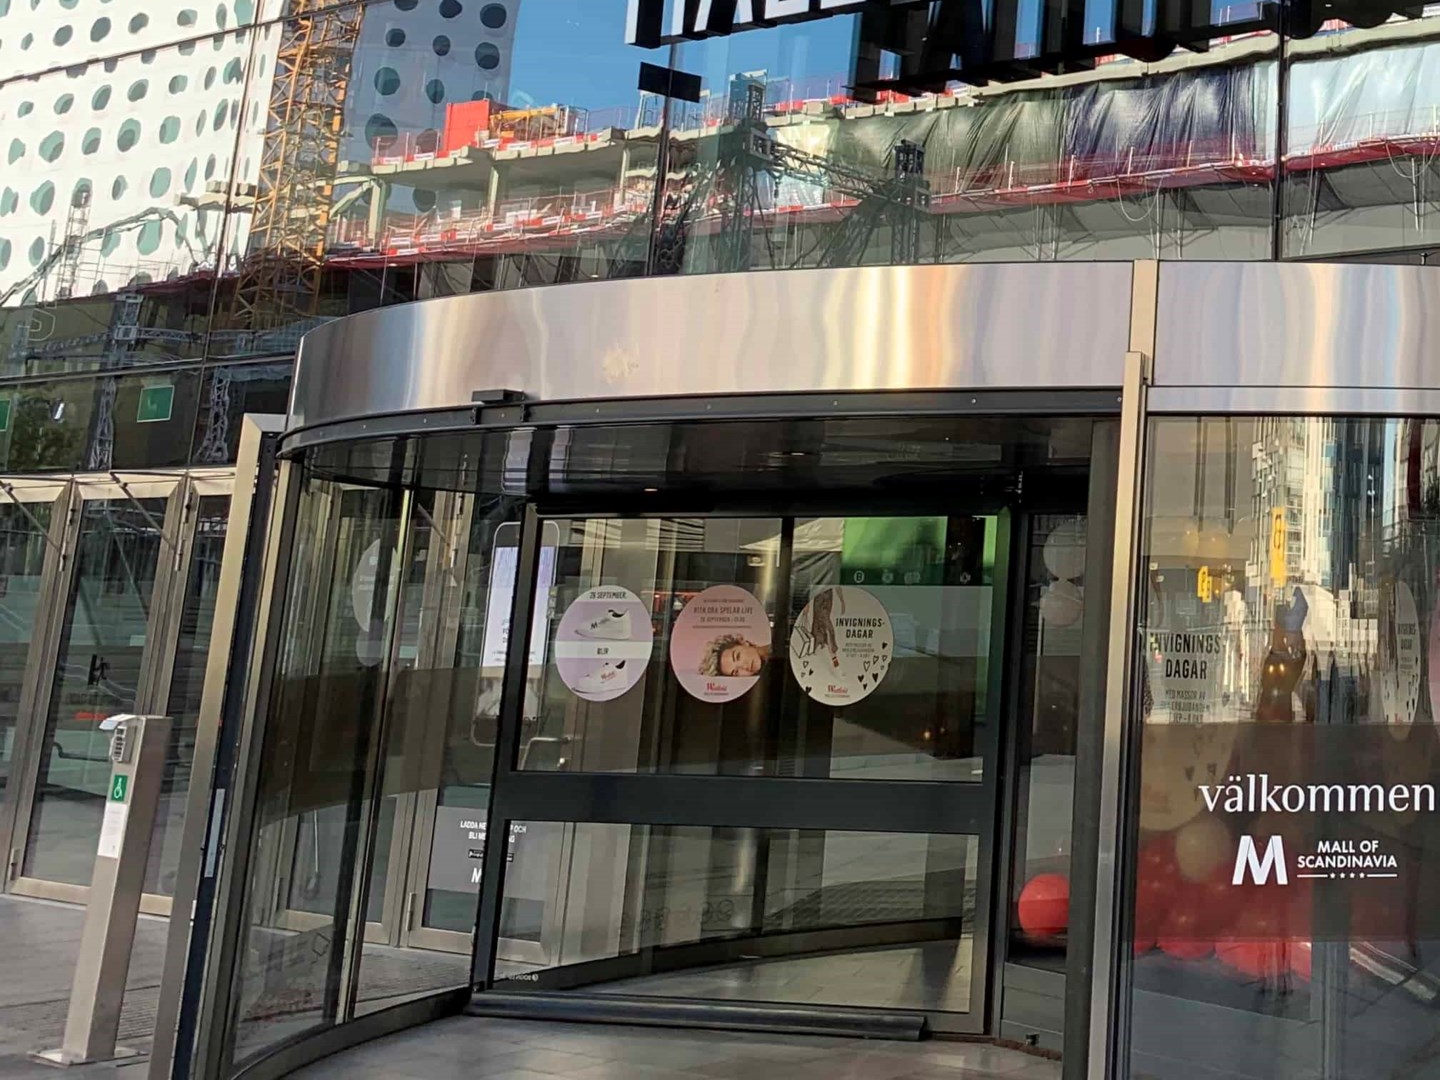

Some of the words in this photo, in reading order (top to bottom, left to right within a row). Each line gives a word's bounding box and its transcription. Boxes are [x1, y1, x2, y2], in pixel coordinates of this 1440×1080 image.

[846, 629, 874, 639] DAGAR
[1165, 659, 1207, 680] DAGAR
[1198, 774, 1436, 813] välkommen
[1317, 840, 1356, 854] MALL
[1359, 839, 1380, 853] OF
[1296, 854, 1398, 869] SCANDINAVIA
